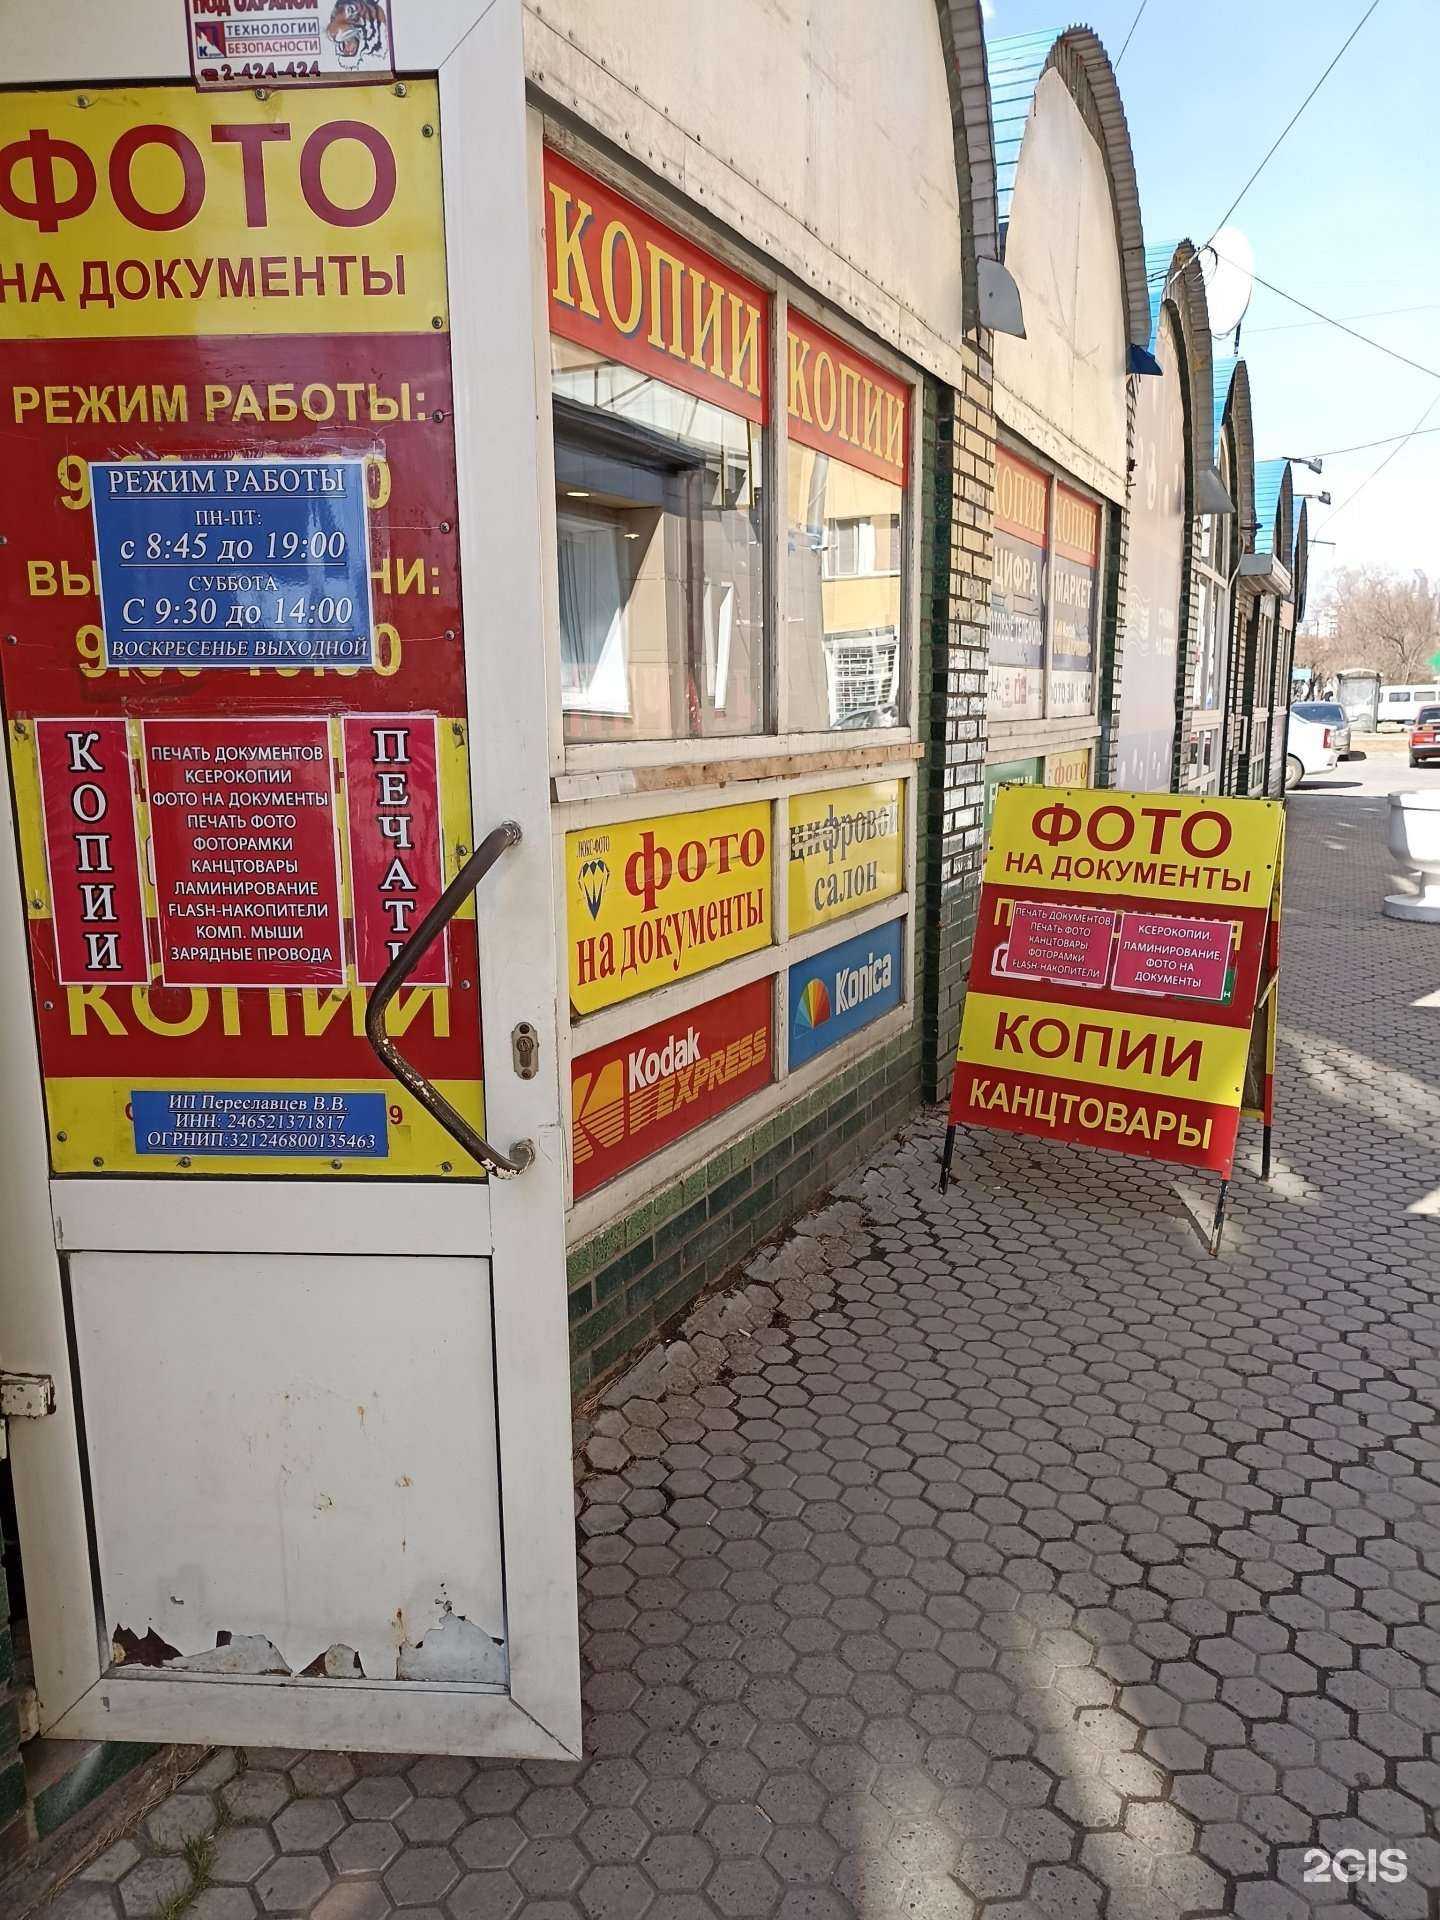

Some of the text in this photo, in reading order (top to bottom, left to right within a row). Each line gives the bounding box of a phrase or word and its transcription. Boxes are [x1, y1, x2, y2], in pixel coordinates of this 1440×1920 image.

[226, 22, 318, 36] ТЕХНОЛОГИИ
[228, 40, 319, 54] БЕЗОПАСНОСТИ
[221, 61, 321, 81] 2-424-424
[0, 120, 397, 233] ФОТО
[0, 254, 406, 309] НА ДОКУМЕНТЫ
[549, 182, 761, 398] КОПИИ
[13, 383, 427, 424] РЕЖИМ РАБОТЫ:
[787, 331, 905, 467] КОПИИ
[109, 470, 215, 493] РЕЖИМ
[224, 469, 345, 492] РАБОТЫ
[195, 510, 262, 526] ПН-ПТ:
[146, 532, 208, 560] 8:45
[217, 540, 253, 562] до
[267, 531, 345, 559] 19:00
[188, 576, 279, 592] СУББОТА
[994, 545, 1092, 609] ЦИФРА МАРКЕТ
[155, 598, 217, 624] 9:30
[225, 605, 262, 627] до
[274, 597, 353, 624] 14:00
[111, 636, 367, 658] ВОСКРЕСЕНЬЕ ВЫХОДНОЙ
[152, 746, 324, 763] ПЕЧАТЬ ДОКУМЕНТОВ
[185, 769, 292, 783] КСЕРОКОПИИ
[153, 792, 328, 808] ФОТО НА ДОКУМЕНТЫ
[187, 814, 296, 828] ПЕЧАТЬ ФОТО
[789, 795, 899, 865] цифровой
[1031, 802, 1232, 859] ФОТО
[67, 733, 122, 969] КОПИИ
[193, 837, 293, 851] ФОТОРАМКИ
[191, 859, 298, 875] КАНЦТОВАРЫ
[624, 827, 765, 912] фото
[1005, 852, 1251, 893] НА ДОКУМЕНТЫ
[174, 881, 319, 896] ЛАМИНИРОВАНИЕ
[814, 861, 878, 911] салон
[168, 903, 328, 917] FLASH-НАКОПИТЕЛИ
[1016, 907, 1047, 919] ПЕЧАТЬ
[196, 925, 303, 939] КОМП. МЫШИ
[577, 888, 764, 986] на документы
[1031, 922, 1091, 937] ПЕЧАТЬ ФОТО
[1029, 935, 1088, 950] КАНЦТОВАРЫ
[171, 947, 333, 962] ЗАРЯДНЫЕ ПРОВОДА
[1028, 948, 1085, 962] ФОТОРАМКИ
[1146, 958, 1194, 972] ФОТО НА
[834, 952, 893, 1016] Konica
[994, 1012, 1204, 1082] КОПИИ
[628, 1026, 701, 1093] Kodak
[629, 1026, 767, 1136] EXPRESS
[169, 1095, 348, 1111] ИП Переславцев В.В.
[175, 1113, 345, 1128] ИНН: 246521371817
[968, 1078, 1214, 1150] КАНЦТОВАРЫ
[147, 1131, 376, 1149] ОГРНИП:321246800135463
